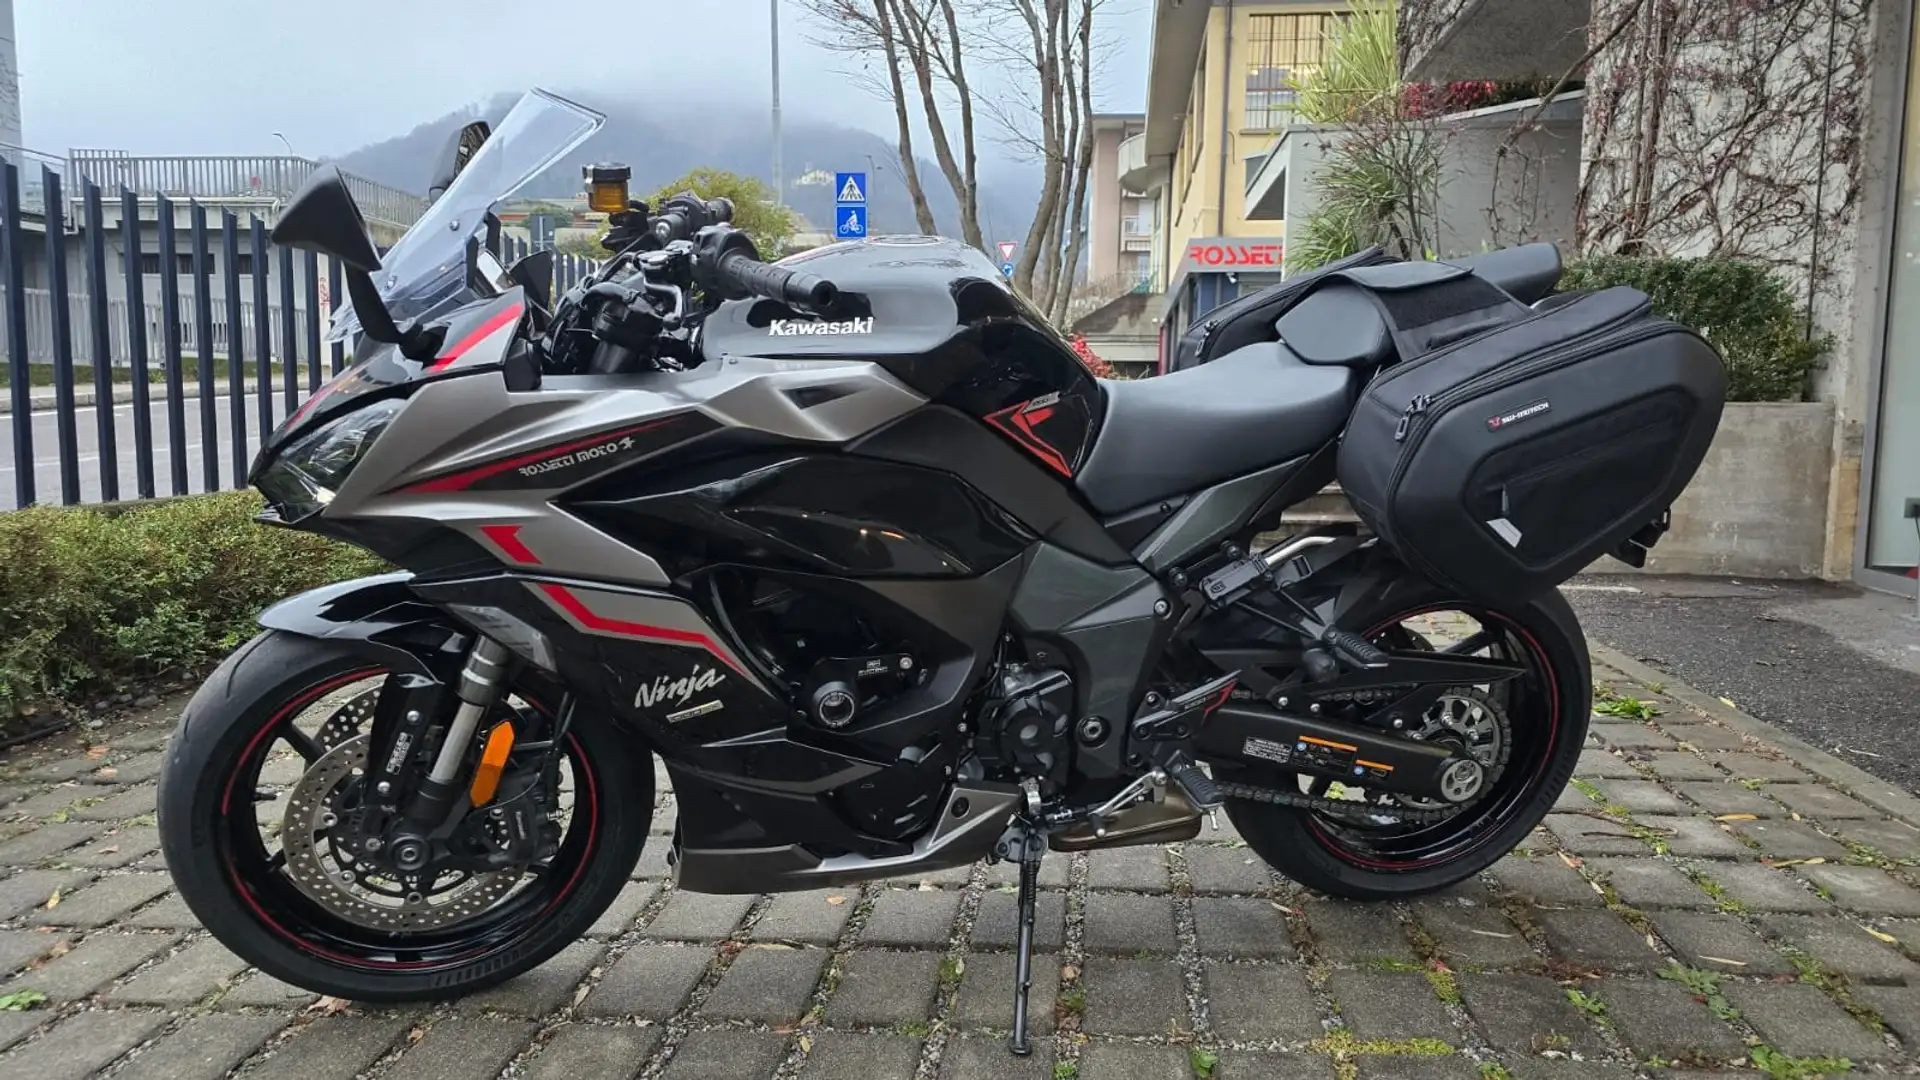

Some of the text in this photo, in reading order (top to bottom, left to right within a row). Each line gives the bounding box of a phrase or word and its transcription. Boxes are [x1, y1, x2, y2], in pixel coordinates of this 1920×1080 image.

[1189, 244, 1283, 266] ROSSET
[768, 316, 874, 336] Kawasaki
[518, 442, 619, 477] ROSSETTI MOTO
[634, 663, 726, 708] Ninja
